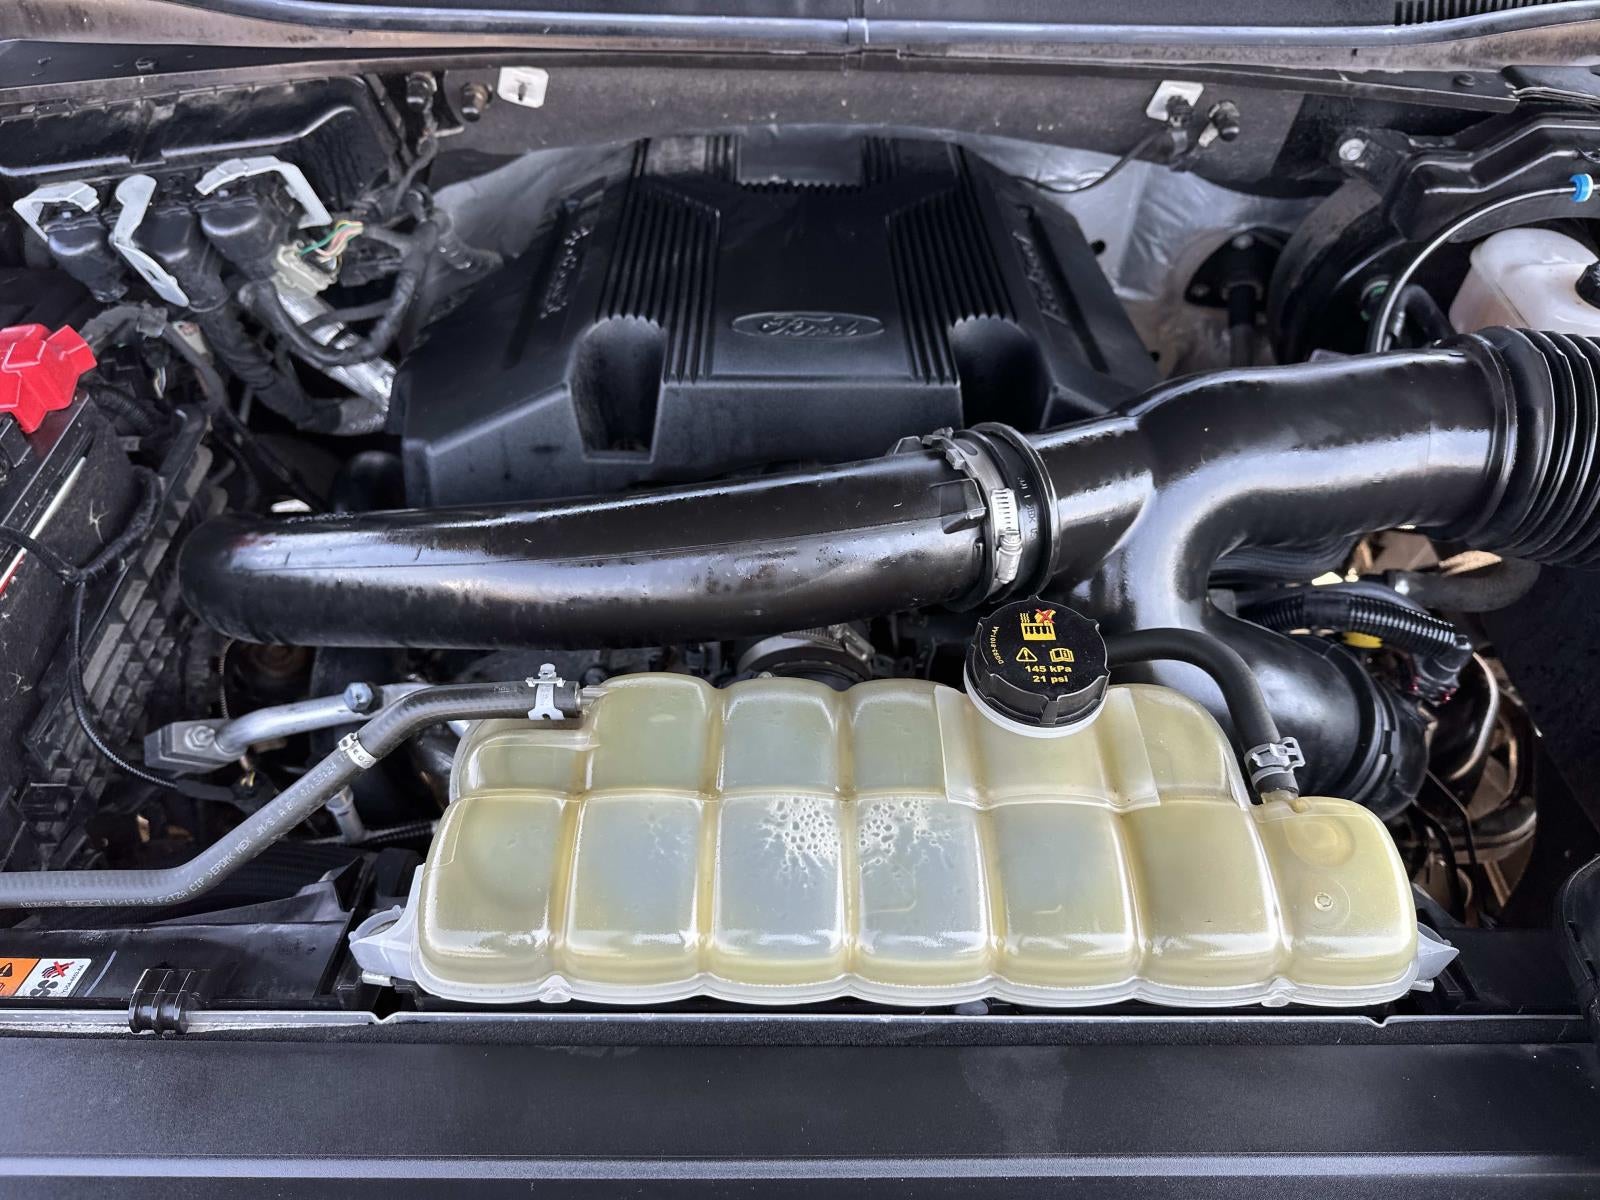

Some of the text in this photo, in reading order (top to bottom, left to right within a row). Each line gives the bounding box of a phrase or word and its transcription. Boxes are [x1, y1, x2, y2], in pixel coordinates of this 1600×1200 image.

[758, 314, 862, 338] Ford
[1025, 665, 1072, 673] 145 kPa
[1032, 675, 1068, 684] 21 psi
